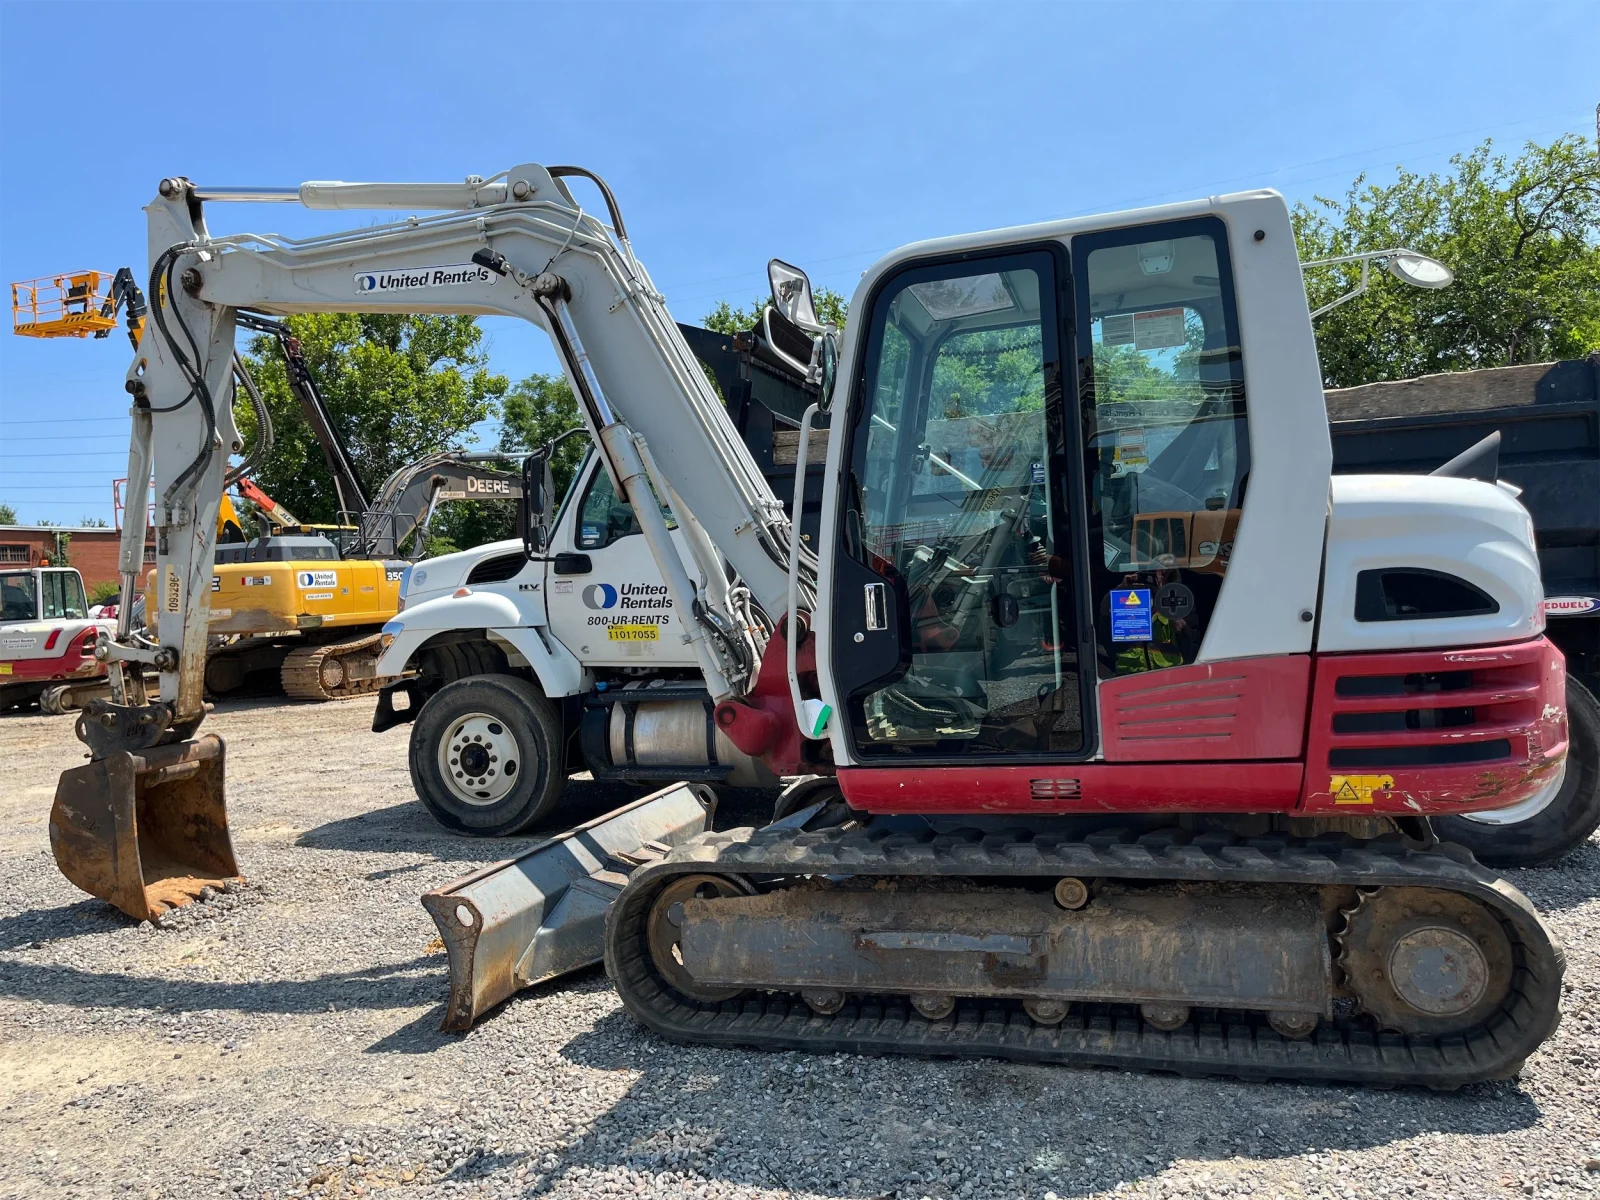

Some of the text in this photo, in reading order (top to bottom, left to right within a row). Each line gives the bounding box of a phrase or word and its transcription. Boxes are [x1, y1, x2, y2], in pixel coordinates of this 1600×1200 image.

[379, 267, 489, 289] United Rentals
[467, 475, 510, 494] DEERE
[280, 512, 292, 523] JLG
[620, 583, 668, 595] United
[620, 596, 673, 609] Rentals
[587, 615, 670, 626] 800-UR-RENTS
[609, 630, 656, 639] 11017055
